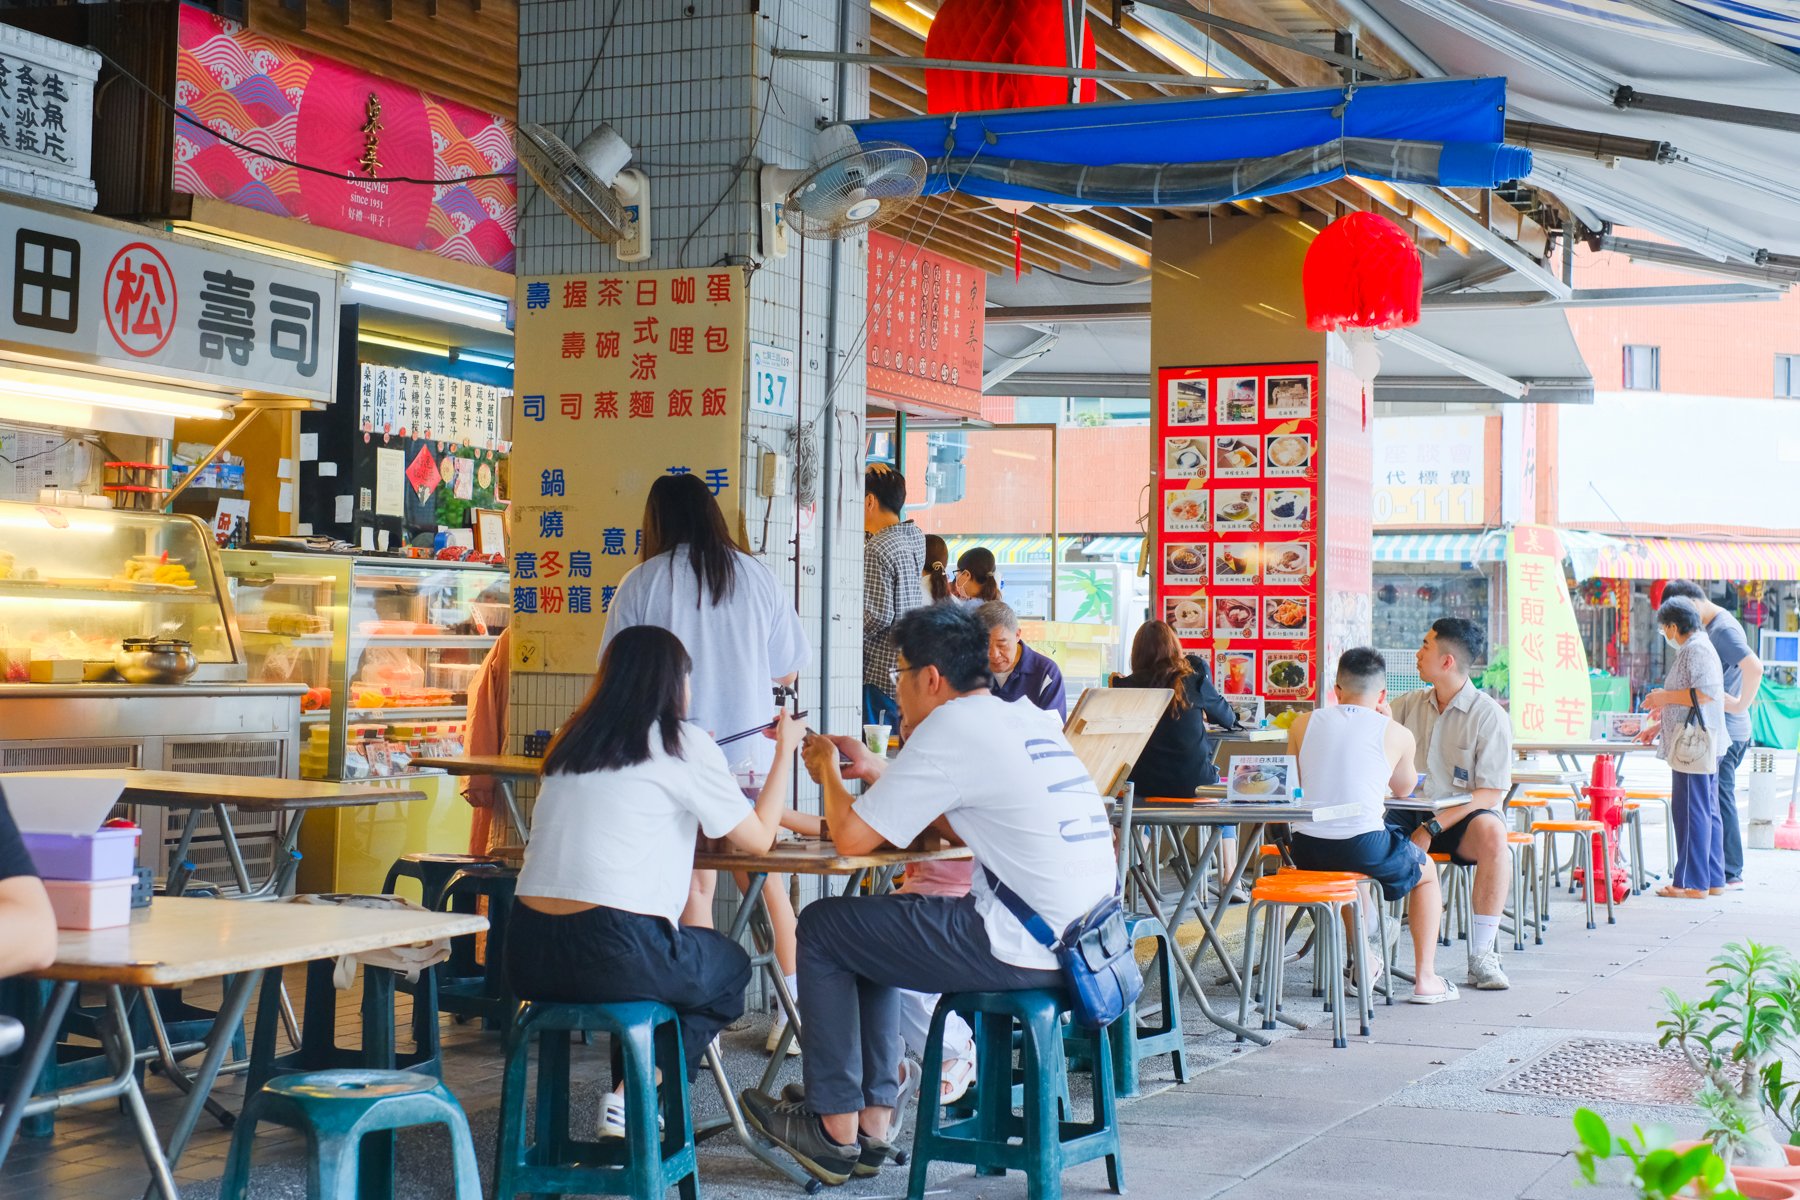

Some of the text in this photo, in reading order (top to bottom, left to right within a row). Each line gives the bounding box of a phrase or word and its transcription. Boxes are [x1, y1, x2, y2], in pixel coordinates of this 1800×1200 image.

[15, 65, 41, 154] 各式沙拉
[41, 73, 70, 163] 生魚片
[350, 191, 384, 210] since 1951
[13, 228, 81, 334] 田
[198, 269, 321, 378] 壽司
[522, 281, 551, 422] 壽司
[559, 280, 587, 420] 握壽司
[593, 278, 623, 419] 茶碗蒸
[629, 279, 659, 419] 日式涼麵
[667, 276, 695, 418] 咖哩飯
[701, 273, 731, 417] 蛋包飯
[398, 372, 408, 417] 西瓜汁
[449, 380, 458, 440] 奇異果汁
[463, 384, 472, 428] 鳳梨汁
[757, 371, 787, 408] 137
[539, 468, 566, 538] 鍋燒
[512, 550, 538, 614] 意麵
[539, 550, 564, 613] 冬粉
[567, 549, 592, 613] 烏龍
